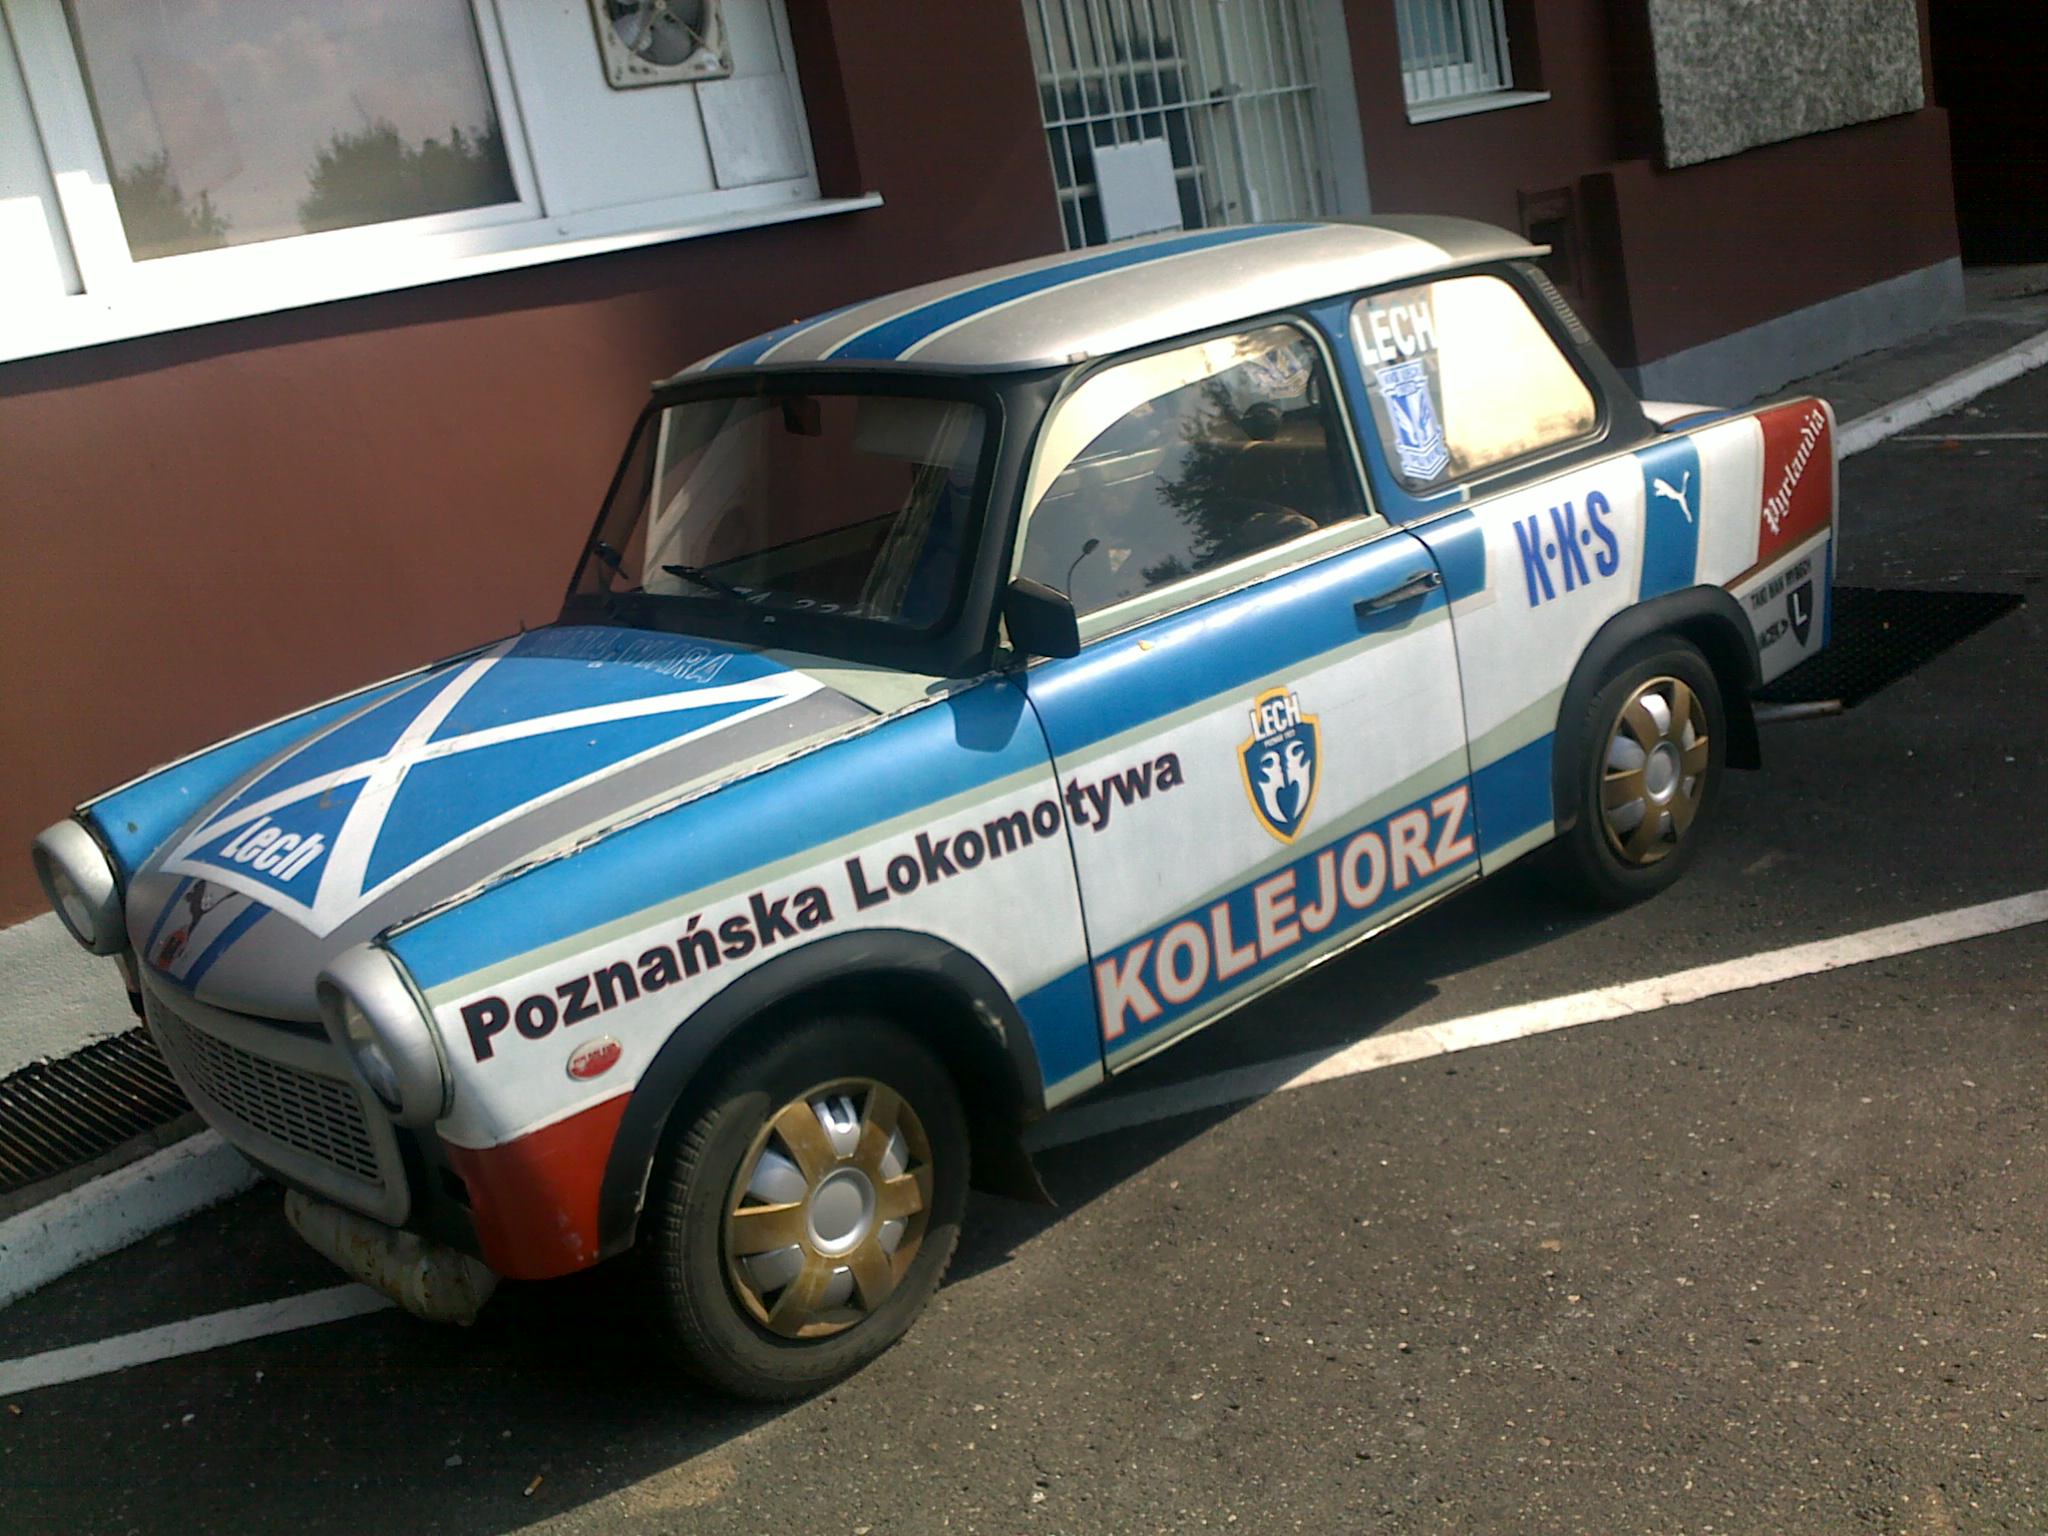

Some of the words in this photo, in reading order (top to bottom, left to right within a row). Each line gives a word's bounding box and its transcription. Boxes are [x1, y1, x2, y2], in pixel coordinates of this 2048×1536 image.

[1351, 301, 1439, 367] LECH
[1763, 408, 1826, 536] Pyrlandia
[1248, 691, 1301, 742] LECH
[459, 884, 835, 1063] Poznańska
[844, 751, 1185, 912] Lokomotywa
[1094, 784, 1475, 1041] KOLEJORZ
